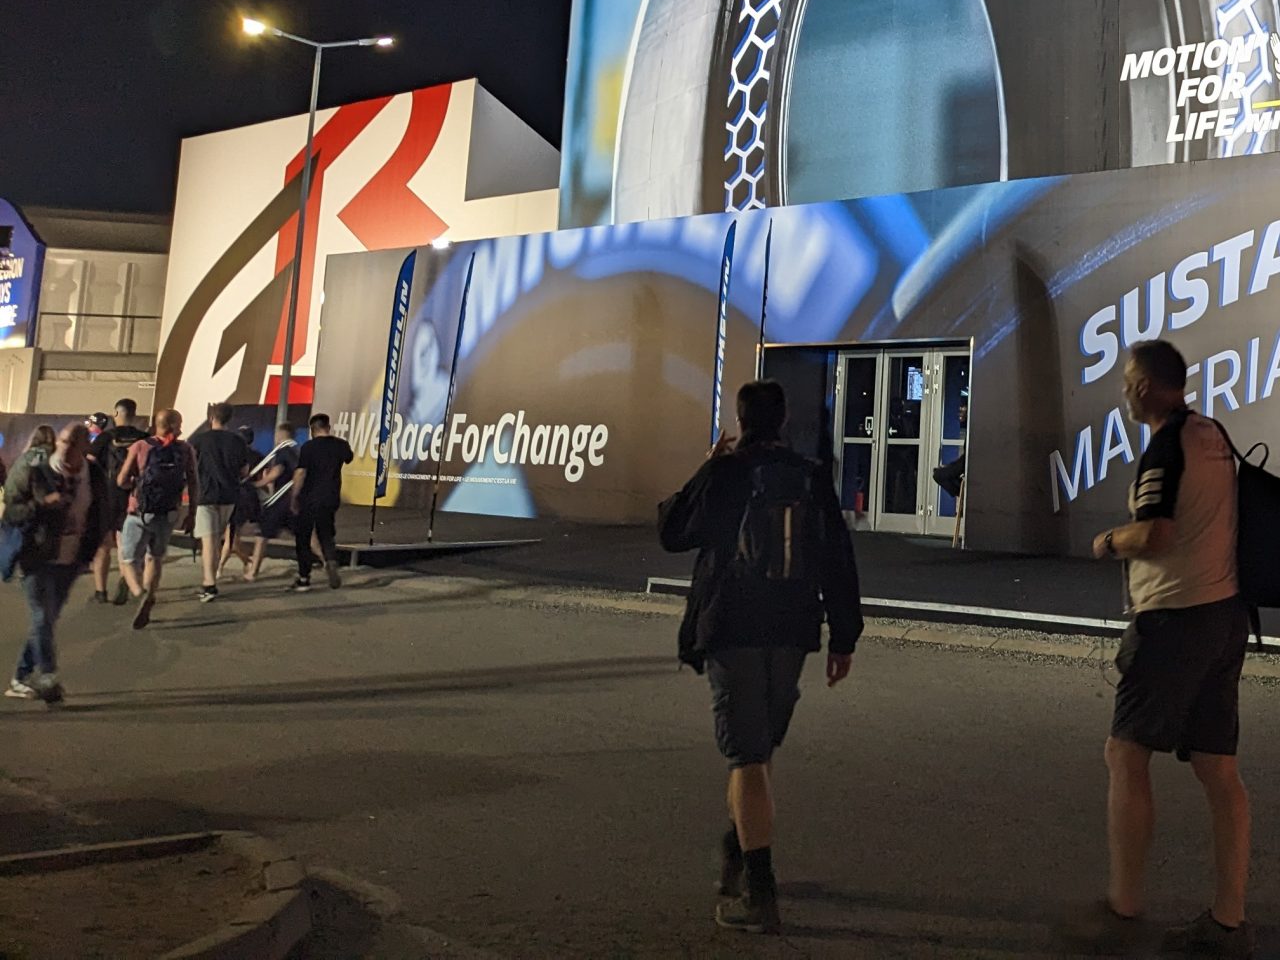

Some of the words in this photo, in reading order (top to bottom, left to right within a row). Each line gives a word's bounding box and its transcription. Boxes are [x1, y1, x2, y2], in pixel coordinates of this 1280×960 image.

[1120, 34, 1258, 82] MOTION
[1176, 72, 1247, 107] FOR
[1165, 107, 1239, 143] LIFE
[385, 280, 409, 431] MICHELIN
[335, 410, 609, 483] #WeRaceForChange
